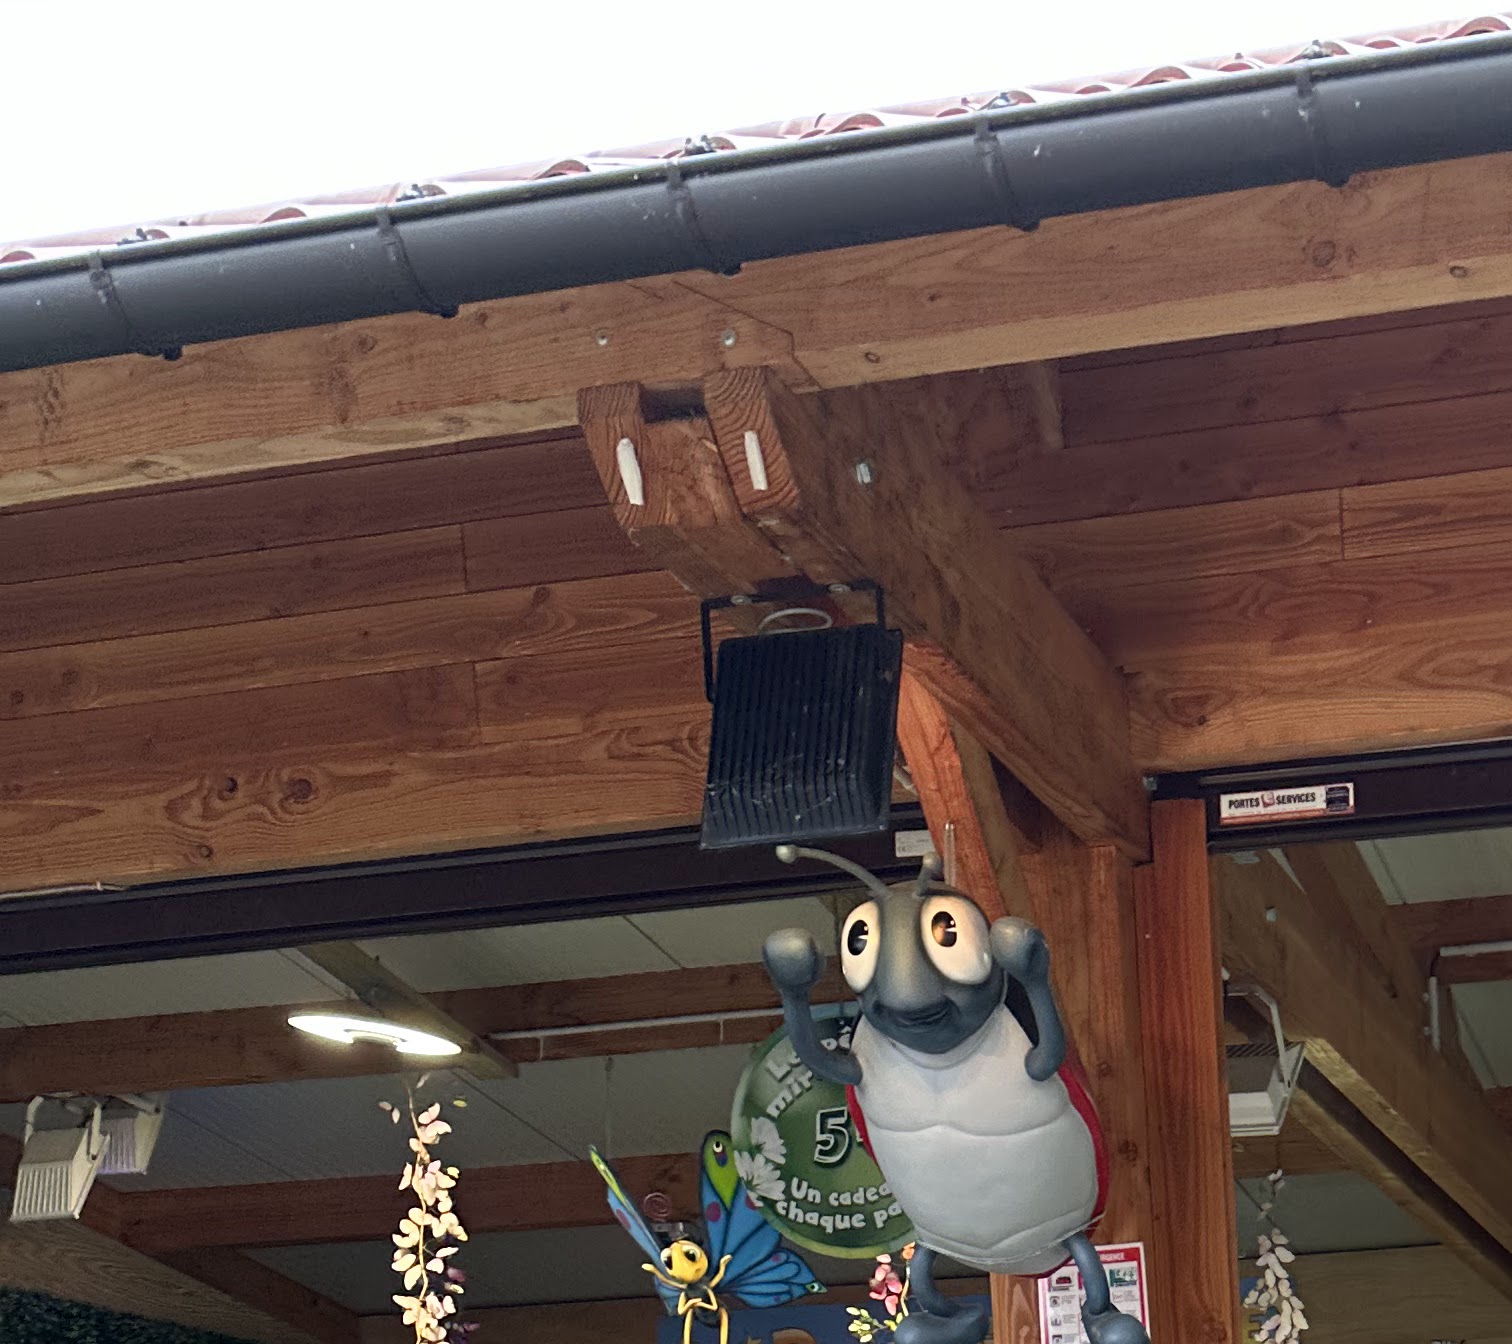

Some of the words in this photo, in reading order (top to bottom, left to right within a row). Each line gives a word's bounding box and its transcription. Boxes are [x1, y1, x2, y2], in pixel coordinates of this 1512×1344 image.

[1228, 797, 1260, 810] PORTES
[1275, 792, 1316, 805] SERVICES
[791, 1177, 821, 1204] Un
[828, 1181, 893, 1207] cadea
[775, 1200, 866, 1234] chaque
